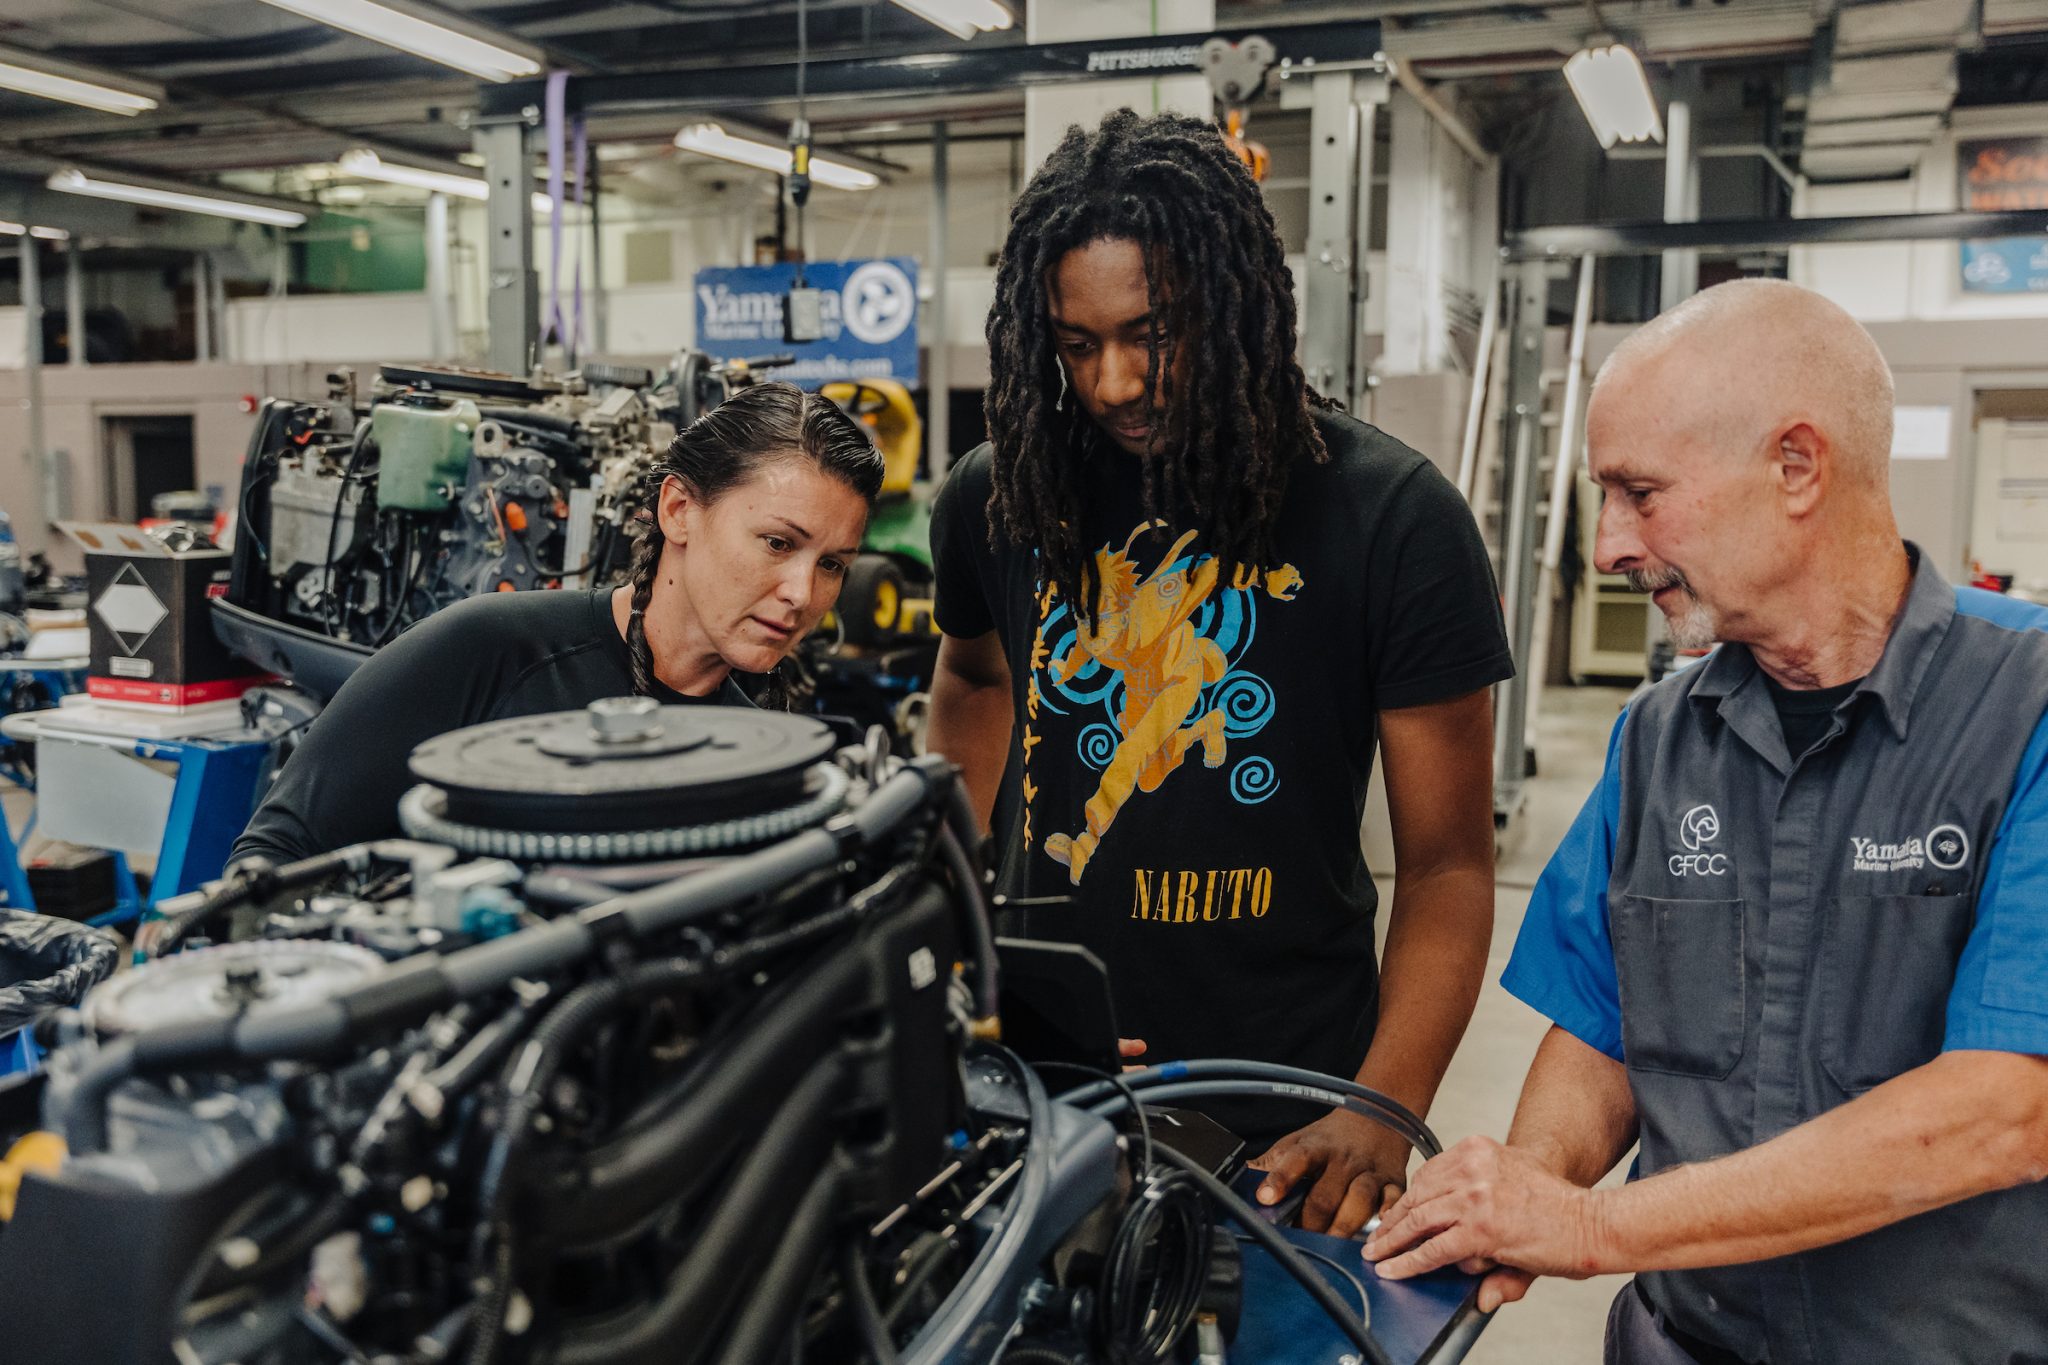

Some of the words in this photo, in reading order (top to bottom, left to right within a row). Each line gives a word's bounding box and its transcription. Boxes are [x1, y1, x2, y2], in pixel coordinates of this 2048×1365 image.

[699, 284, 841, 322] Yama
[1669, 853, 1726, 876] GFCC
[1853, 859, 1888, 871] Marine
[1131, 867, 1273, 922] NARUTO
